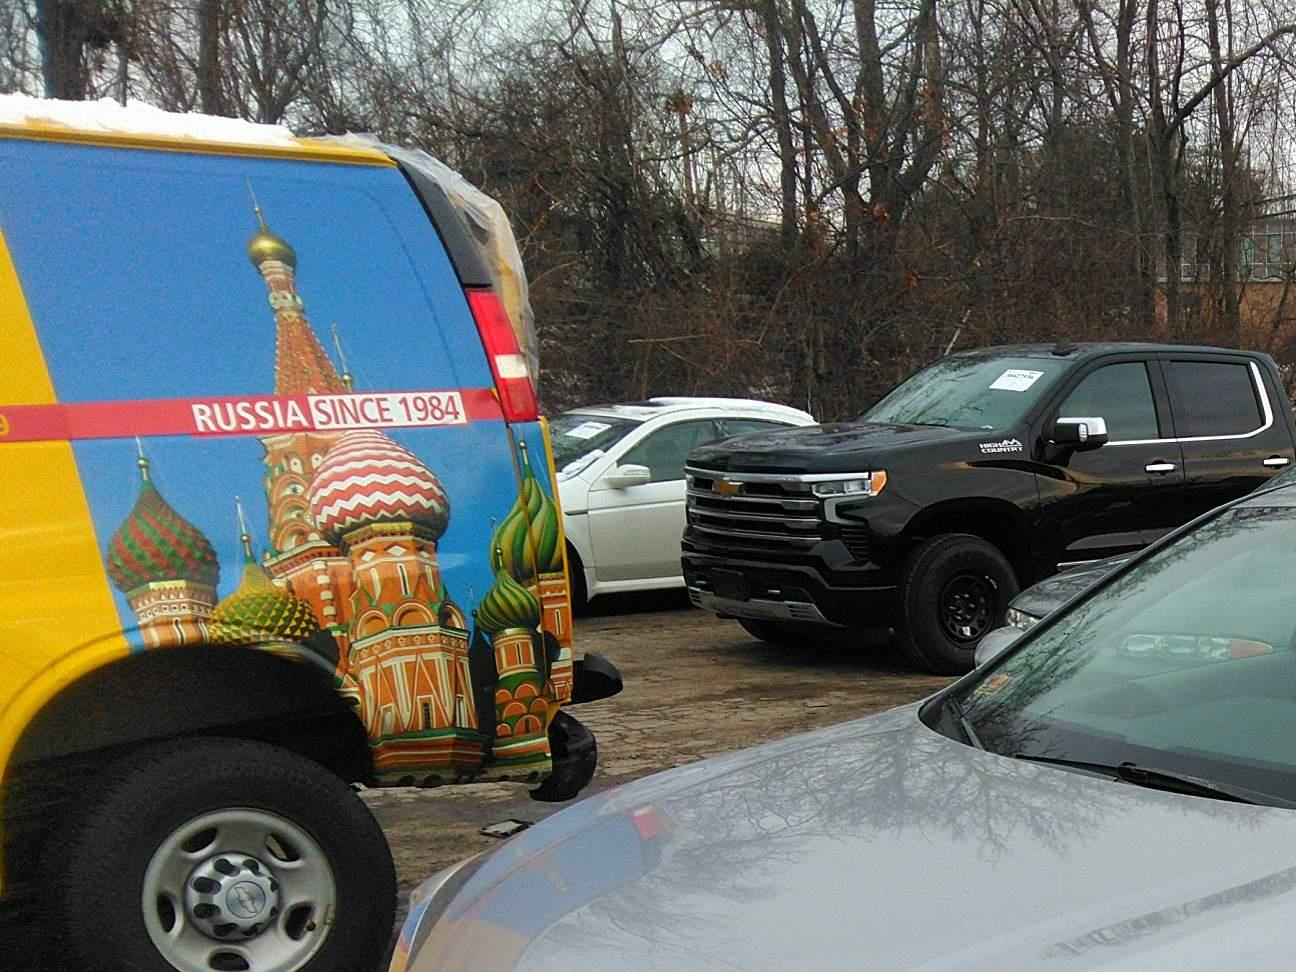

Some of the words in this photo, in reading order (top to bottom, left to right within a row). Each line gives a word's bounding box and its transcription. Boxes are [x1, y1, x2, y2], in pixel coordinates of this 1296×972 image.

[192, 400, 308, 432] RUSSIA
[316, 397, 393, 426] SINCE
[398, 395, 460, 423] 1984
[981, 446, 1023, 454] COUNTRY
